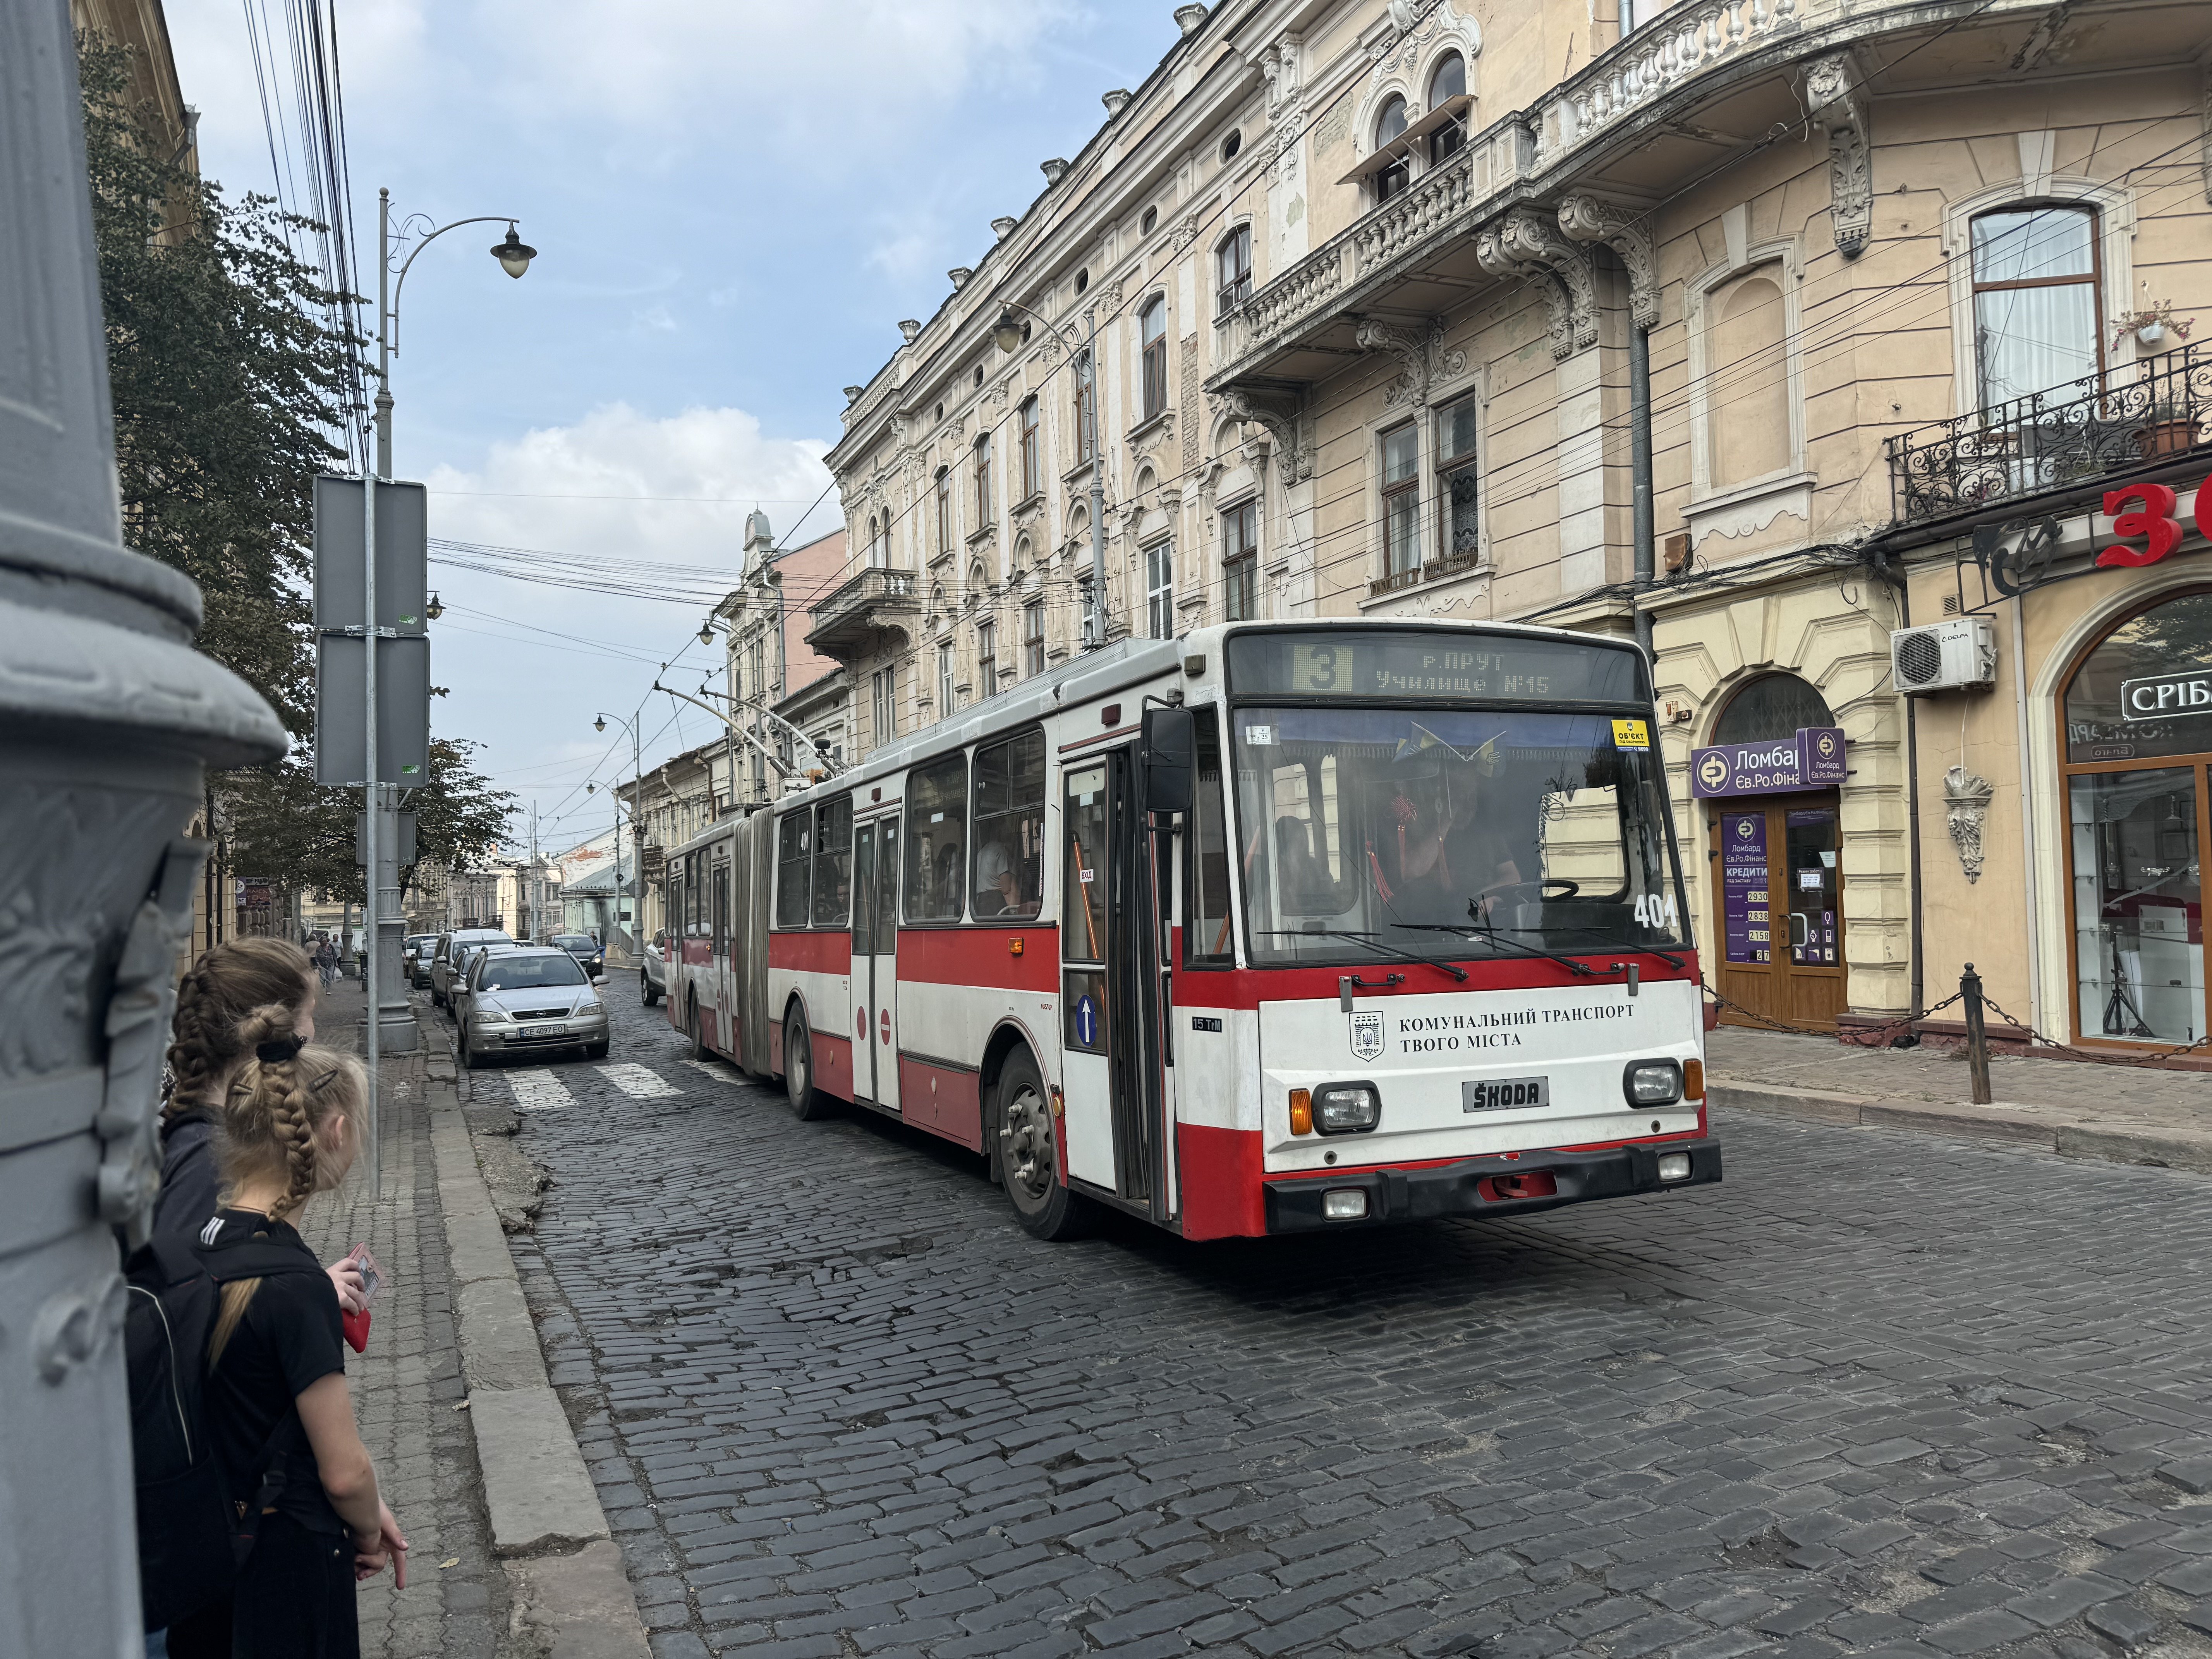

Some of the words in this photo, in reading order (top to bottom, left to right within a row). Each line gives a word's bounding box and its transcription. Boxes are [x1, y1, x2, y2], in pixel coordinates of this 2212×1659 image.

[2095, 471, 2212, 568] З
[1310, 647, 1337, 690] 3
[2131, 679, 2212, 711] СРІБ
[1815, 761, 1839, 770] Ломбард
[1811, 771, 1845, 779] Єв.Ро.Фінанс
[1732, 844, 1761, 853] Ломбард
[1082, 871, 1092, 879] ВХІД
[1726, 867, 1768, 878] КРЕДИТИ
[1748, 893, 1768, 901] 2930
[1634, 893, 1677, 928] 401
[1748, 912, 1768, 921] 2838
[1749, 932, 1769, 940] 2158
[1193, 1018, 1204, 1029] 15
[1399, 1008, 1537, 1032] КОМУНАЛЬНИЙ
[1541, 1004, 1635, 1024] ТРАНСПОРТ
[1400, 1037, 1460, 1053] ТВОГО
[1467, 1033, 1522, 1049] МІСТА
[1473, 1082, 1540, 1109] ŠKODA
